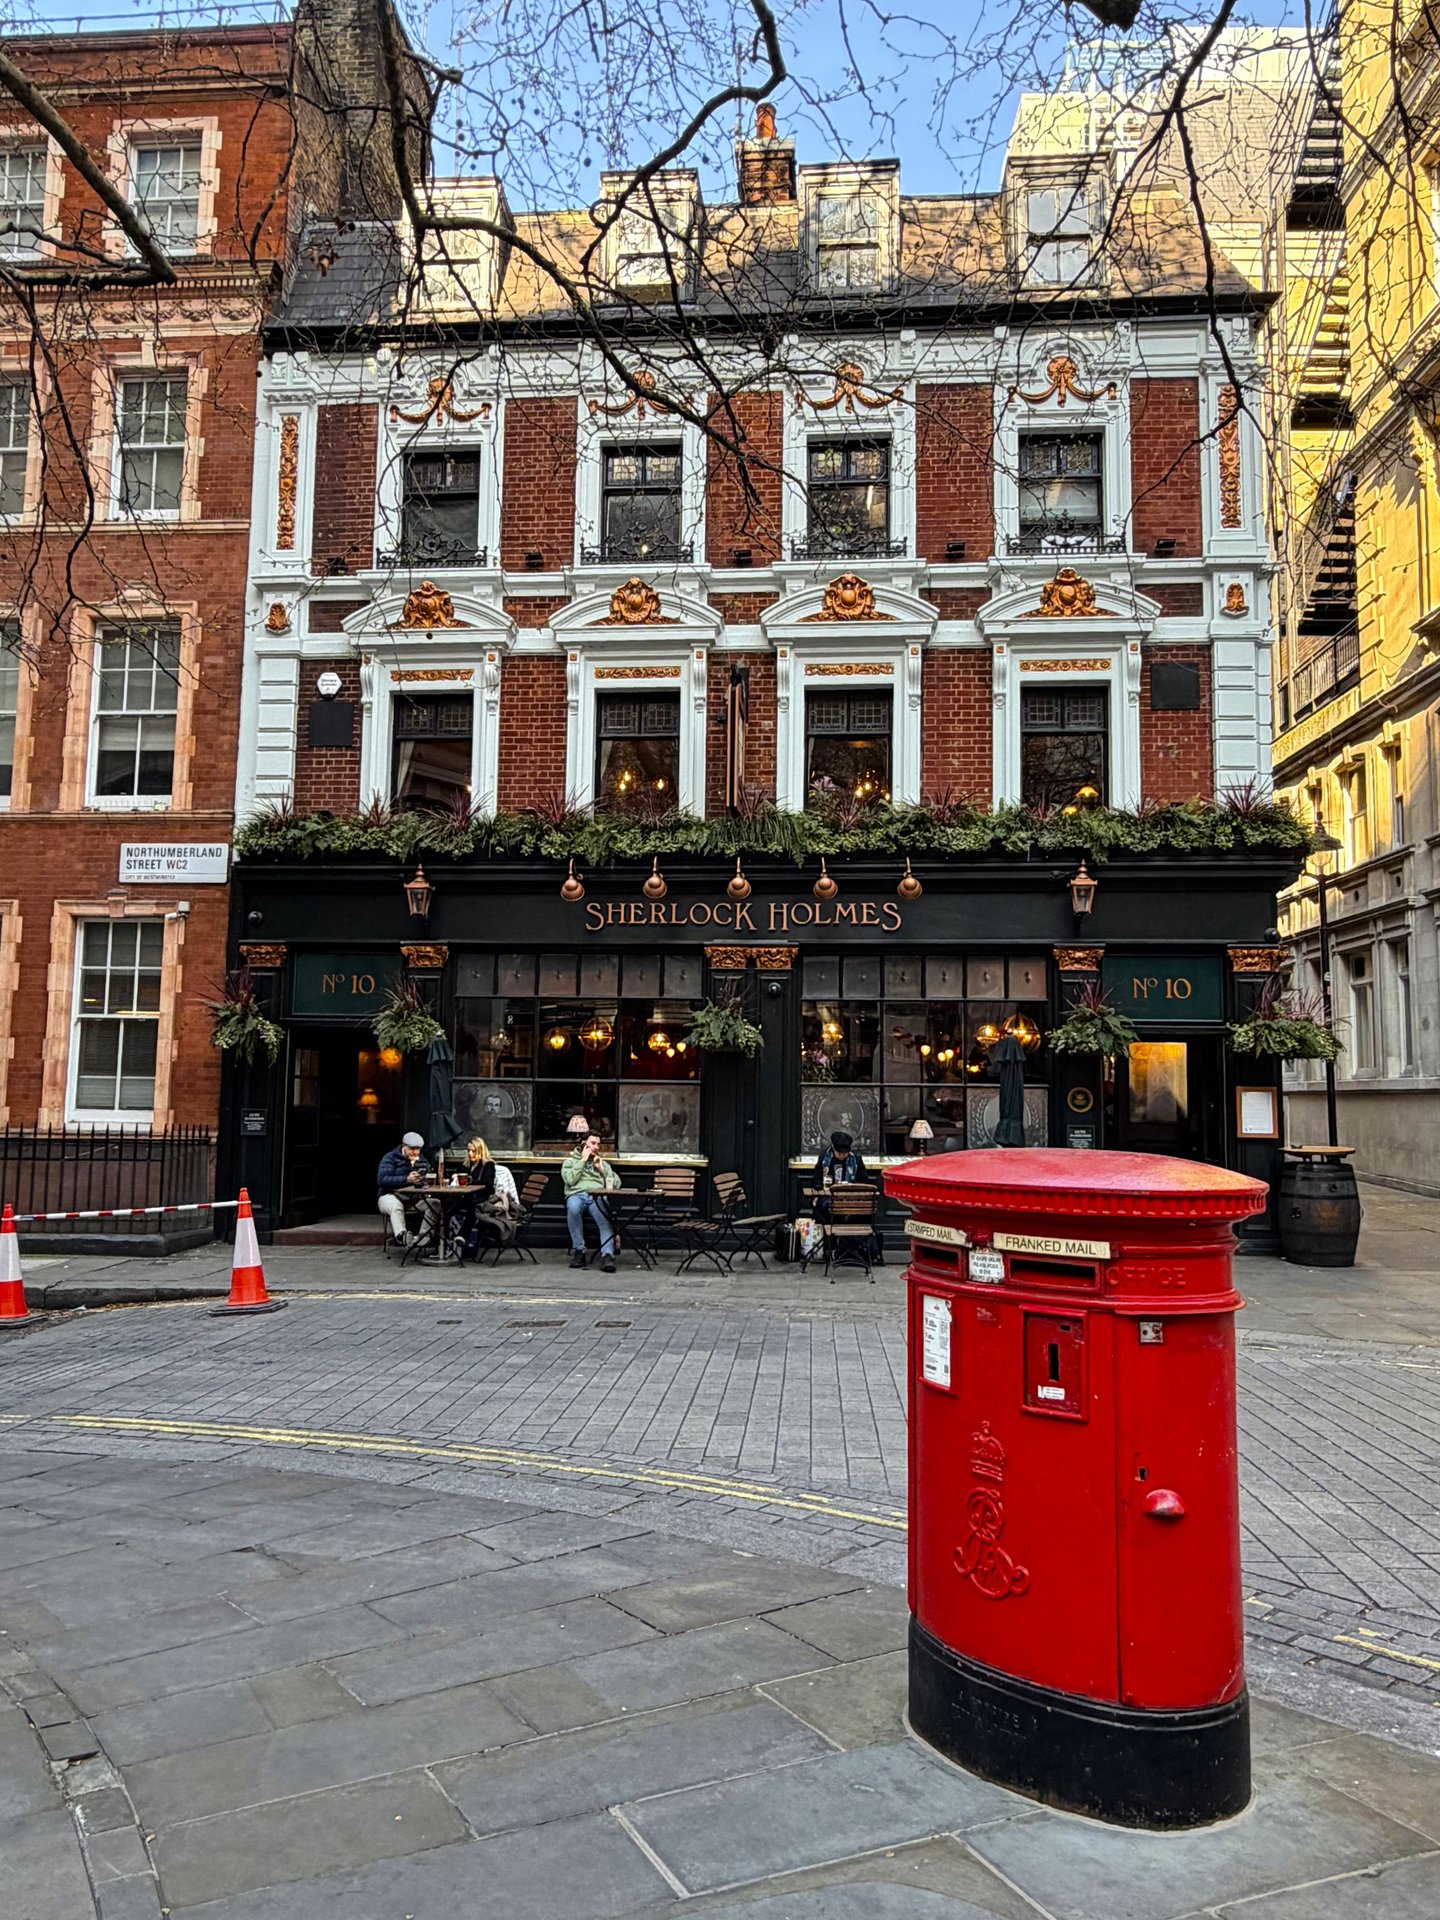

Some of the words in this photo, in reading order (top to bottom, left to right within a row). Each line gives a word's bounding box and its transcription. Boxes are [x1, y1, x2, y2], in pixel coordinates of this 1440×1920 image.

[126, 847, 222, 858] NORTHUMBERLAND
[126, 860, 162, 870] STREET
[166, 860, 188, 870] WC2
[585, 902, 757, 932] SHERLOCK
[768, 902, 902, 932] HOLMES
[351, 974, 376, 994] 10
[1165, 978, 1192, 999] 10
[936, 1228, 954, 1241] MAIL
[1005, 1236, 1062, 1252] FRANKED
[1065, 1242, 1097, 1255] MAIL
[1106, 1266, 1187, 1287] OFFICE
